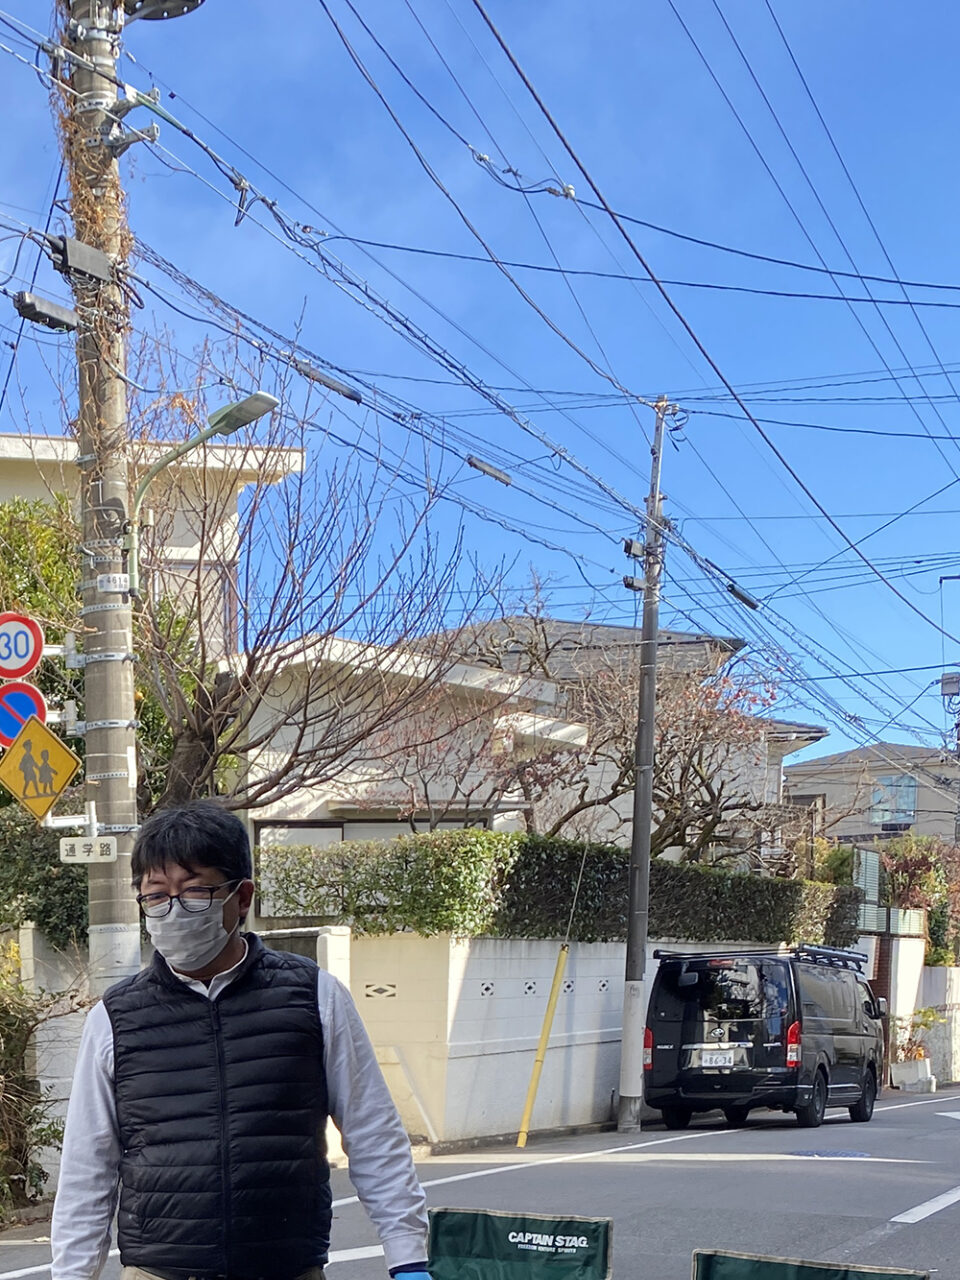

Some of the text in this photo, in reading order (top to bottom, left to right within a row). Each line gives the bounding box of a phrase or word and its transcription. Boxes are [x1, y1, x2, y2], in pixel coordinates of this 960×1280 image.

[64, 842, 112, 857] 通学路
[508, 1231, 554, 1246] CAPTAIN
